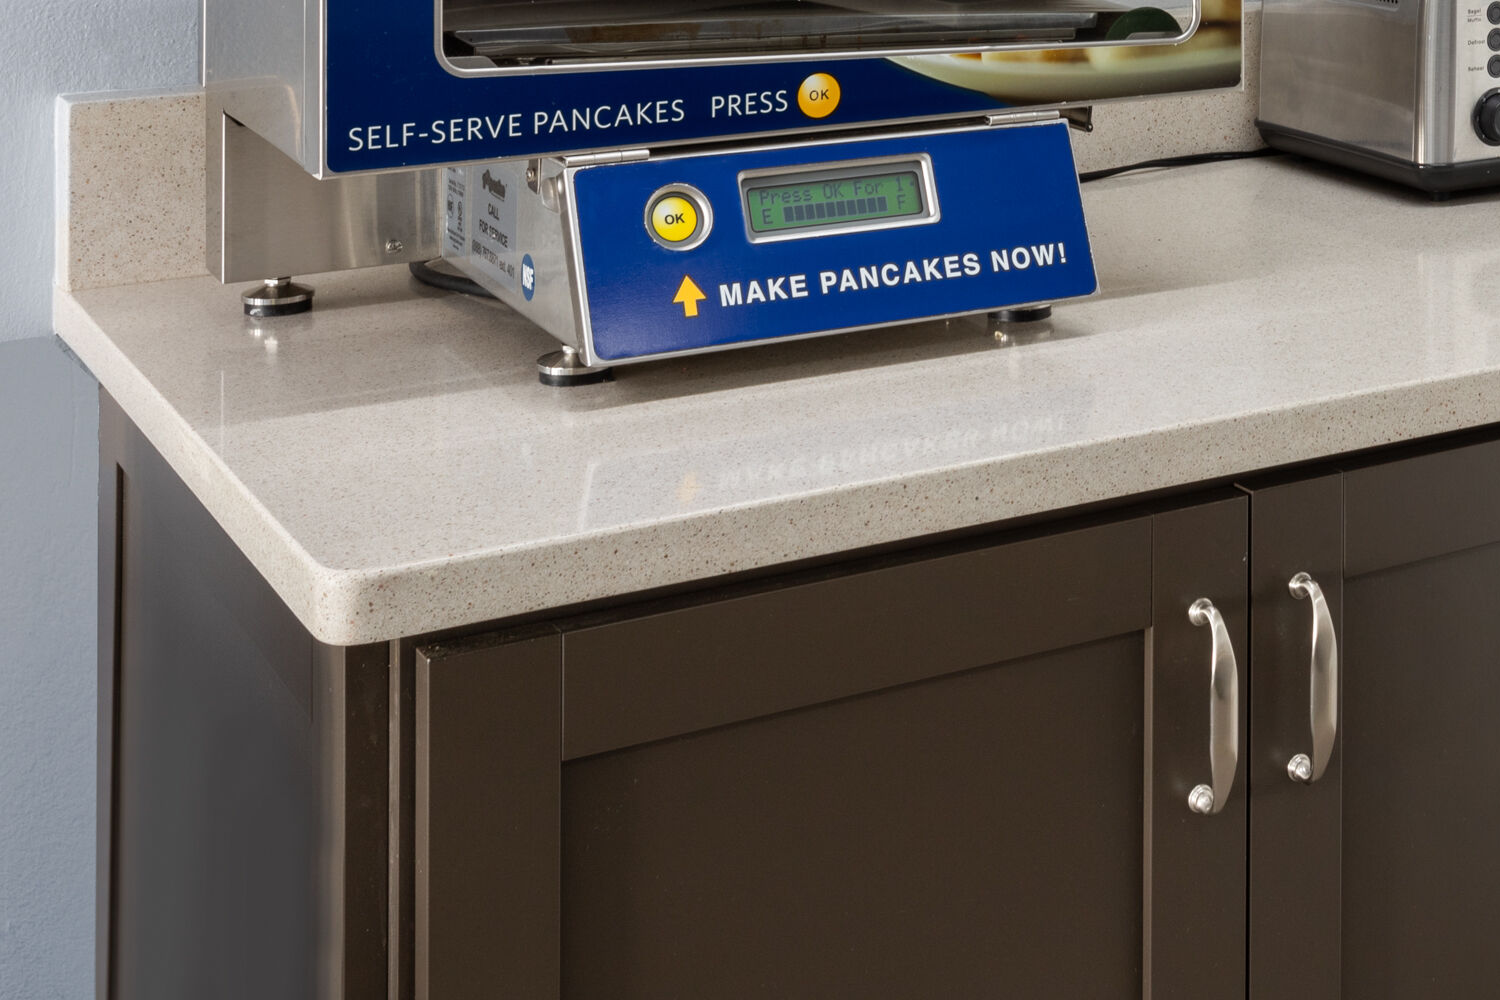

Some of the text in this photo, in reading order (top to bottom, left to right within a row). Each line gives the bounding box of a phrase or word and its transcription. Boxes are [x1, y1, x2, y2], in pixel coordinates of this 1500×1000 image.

[348, 89, 830, 152] SELF-SERVE PANCAKES PRESS OK
[758, 188, 814, 206] Press
[822, 183, 845, 200] OK
[853, 179, 884, 196] For
[488, 202, 500, 221] CALL
[663, 212, 686, 226] OK
[762, 194, 906, 225] E F
[479, 218, 489, 236] FOR
[522, 263, 534, 291] NSF
[718, 241, 1068, 308] MAKE PANCAKES NOW!
